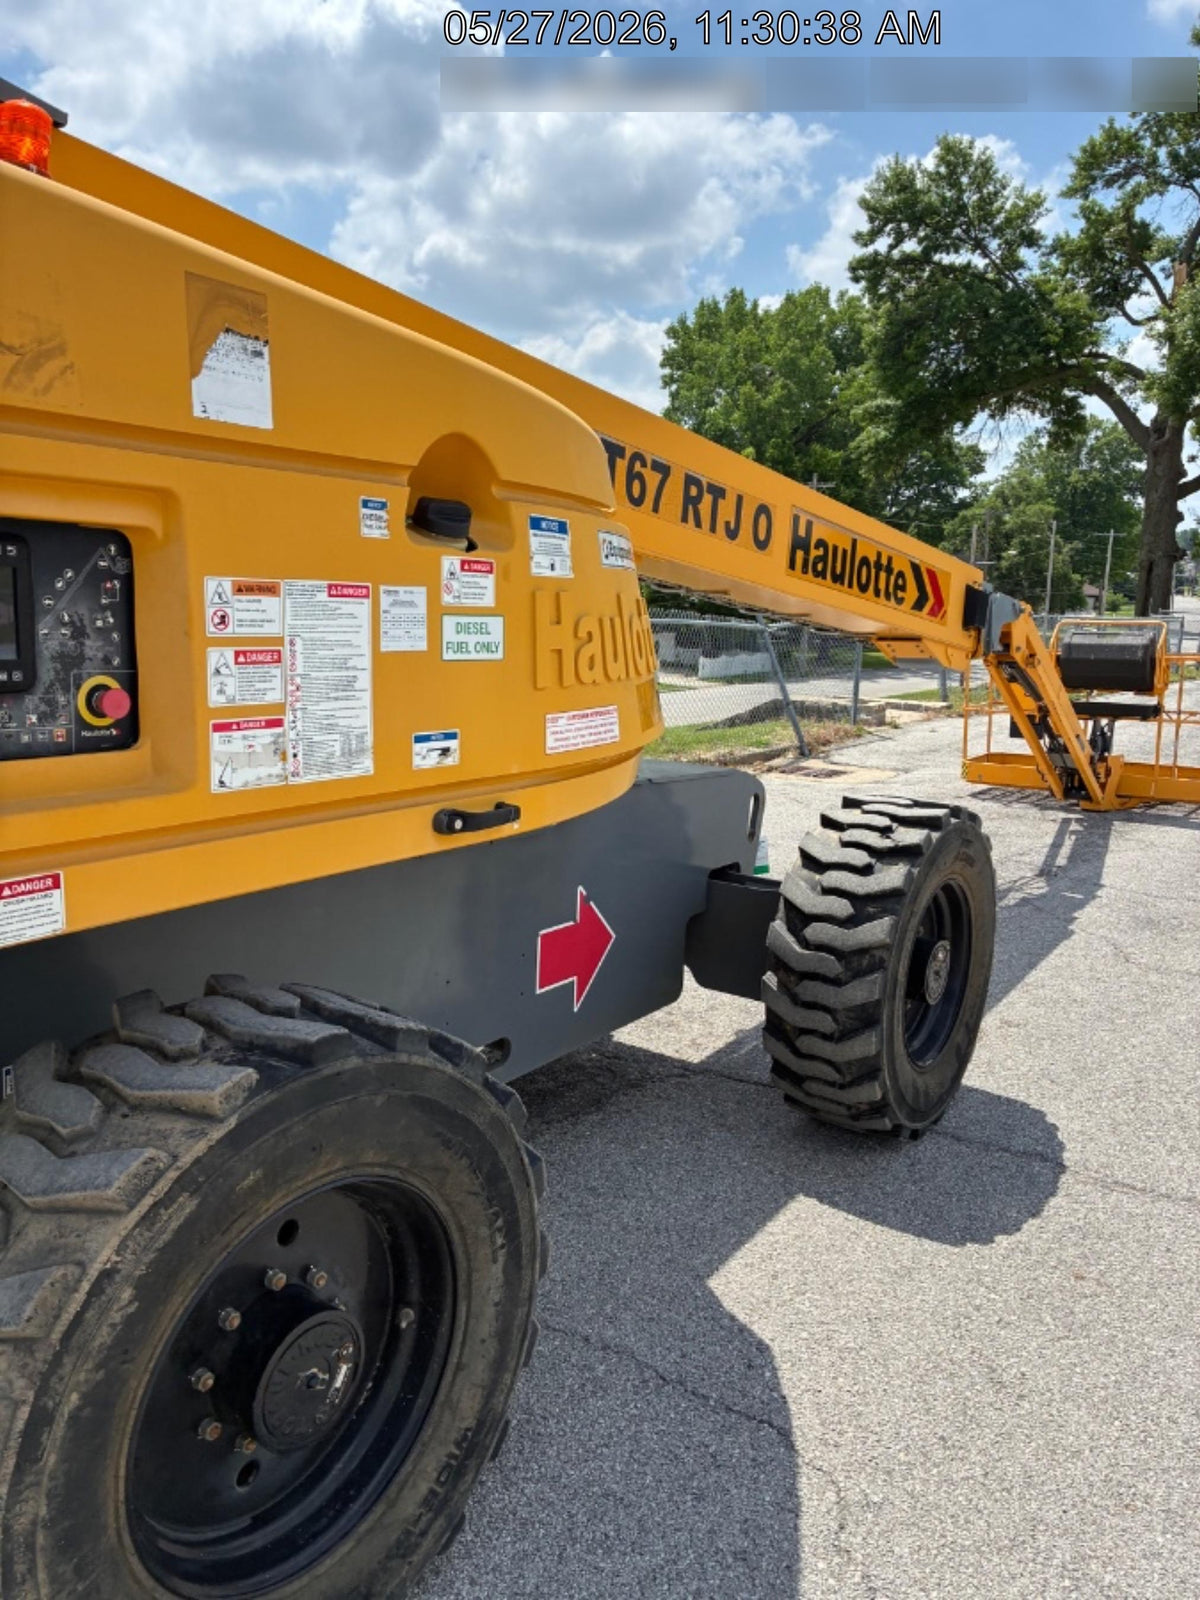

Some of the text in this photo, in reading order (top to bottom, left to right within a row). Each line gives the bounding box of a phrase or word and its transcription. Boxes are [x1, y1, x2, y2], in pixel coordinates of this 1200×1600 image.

[682, 472, 742, 541] RTJ
[789, 514, 907, 605] Haulotte
[455, 621, 491, 636] DIESEL
[445, 640, 501, 655] FUEL ONLY
[246, 651, 280, 663] DANGER
[11, 878, 53, 894] DANGER
